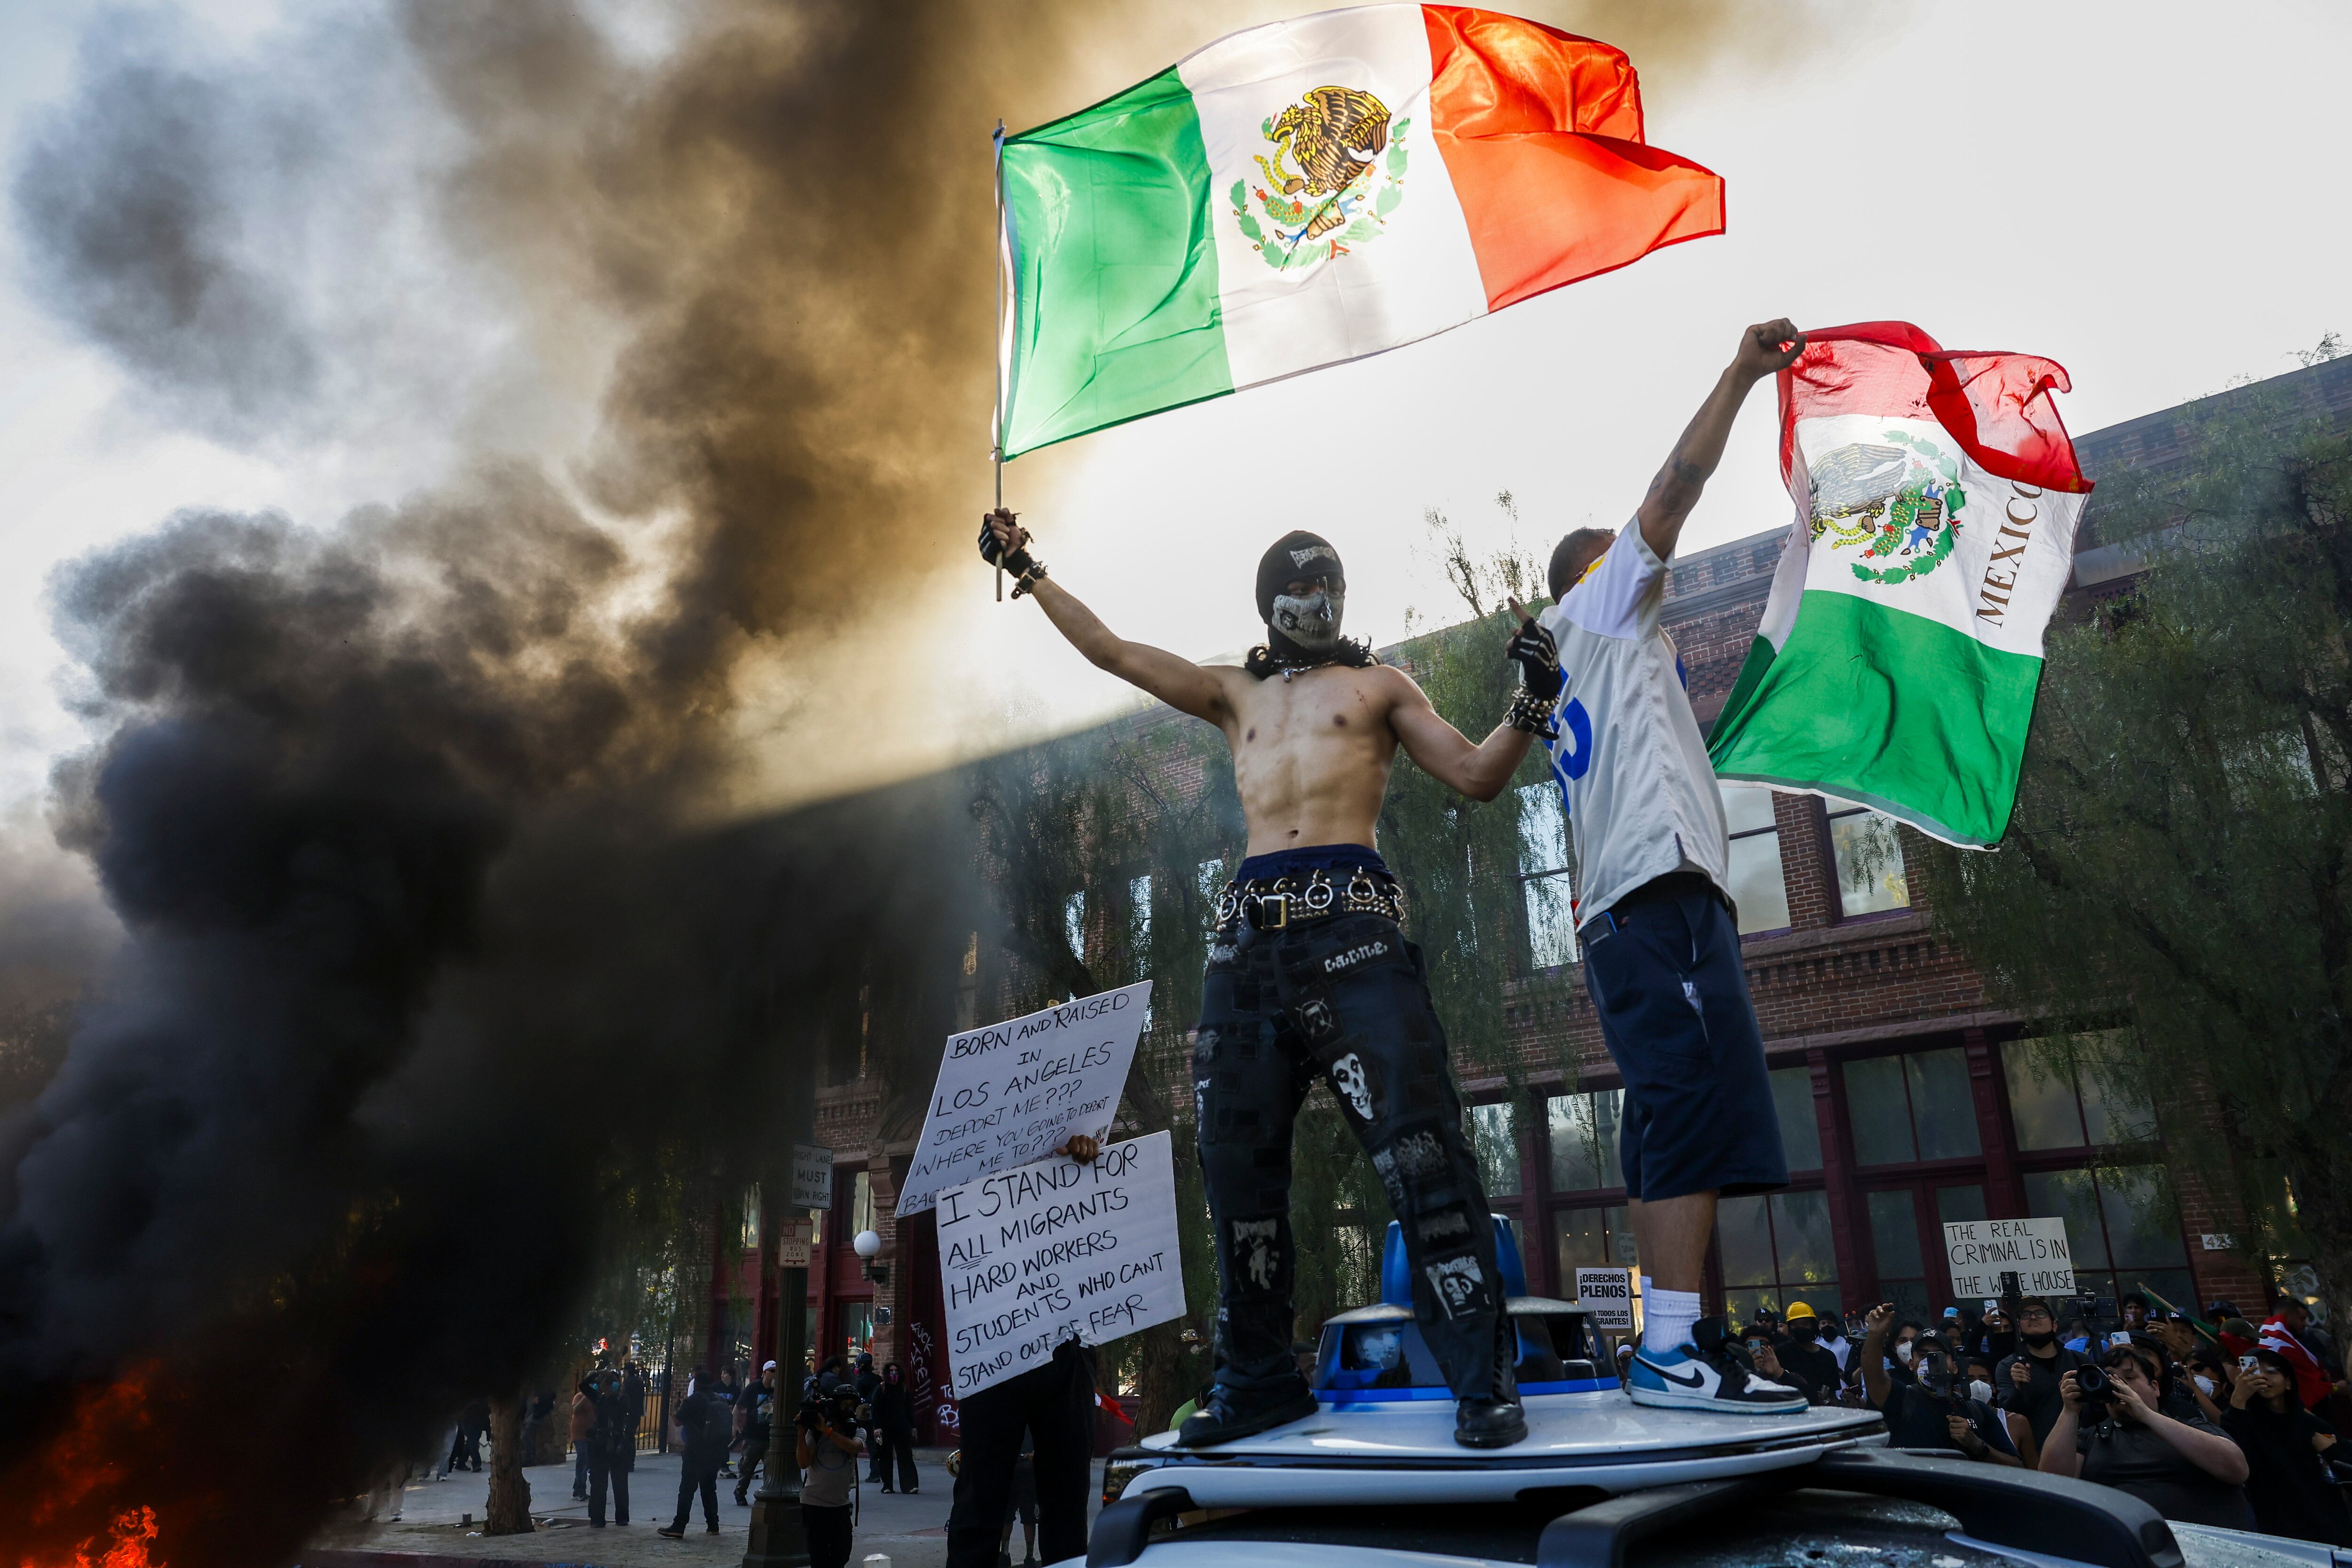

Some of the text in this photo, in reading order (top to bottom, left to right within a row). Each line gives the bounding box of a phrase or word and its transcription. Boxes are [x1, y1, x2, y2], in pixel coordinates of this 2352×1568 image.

[950, 993, 1129, 1059] BORN AND RAISED
[1017, 1049, 1041, 1065] IN
[936, 1041, 1114, 1117] LOS ANGELES
[915, 1139, 985, 1178] WHERE
[997, 1125, 1026, 1147] YOU
[1027, 1113, 1064, 1136] GOING
[1066, 1106, 1077, 1122] TO
[1078, 1096, 1109, 1117] DEPORT
[934, 1106, 1007, 1146] DEPORT
[793, 1151, 831, 1164] RIGHT LANE
[979, 1152, 1004, 1171] ME
[798, 1170, 826, 1184] MUST
[941, 1191, 970, 1227] I
[977, 1163, 1081, 1217] STAND
[1094, 1144, 1138, 1184] FOR
[813, 1191, 829, 1202] RIGHT
[899, 1189, 940, 1216] BAC
[783, 1225, 793, 1235] NO
[947, 1187, 1128, 1266] ALL MIGRANTS
[1946, 1222, 2033, 1241] THE REAL
[1951, 1239, 2067, 1265] CRIMINAL IS IN
[951, 1230, 1118, 1309] HARD WORKERS
[1580, 1274, 1625, 1284] ¡DERECHOS
[1955, 1276, 1983, 1295] THE
[2032, 1270, 2074, 1291] HOUSE
[1017, 1273, 1060, 1300] AND
[1581, 1285, 1626, 1297] PLENOS
[954, 1252, 1164, 1354] STUDENTS WHO CANT
[911, 1322, 933, 1357] FUCK
[958, 1351, 1012, 1388] STAND
[1020, 1333, 1050, 1360] OUT
[1089, 1294, 1147, 1334] FEAR
